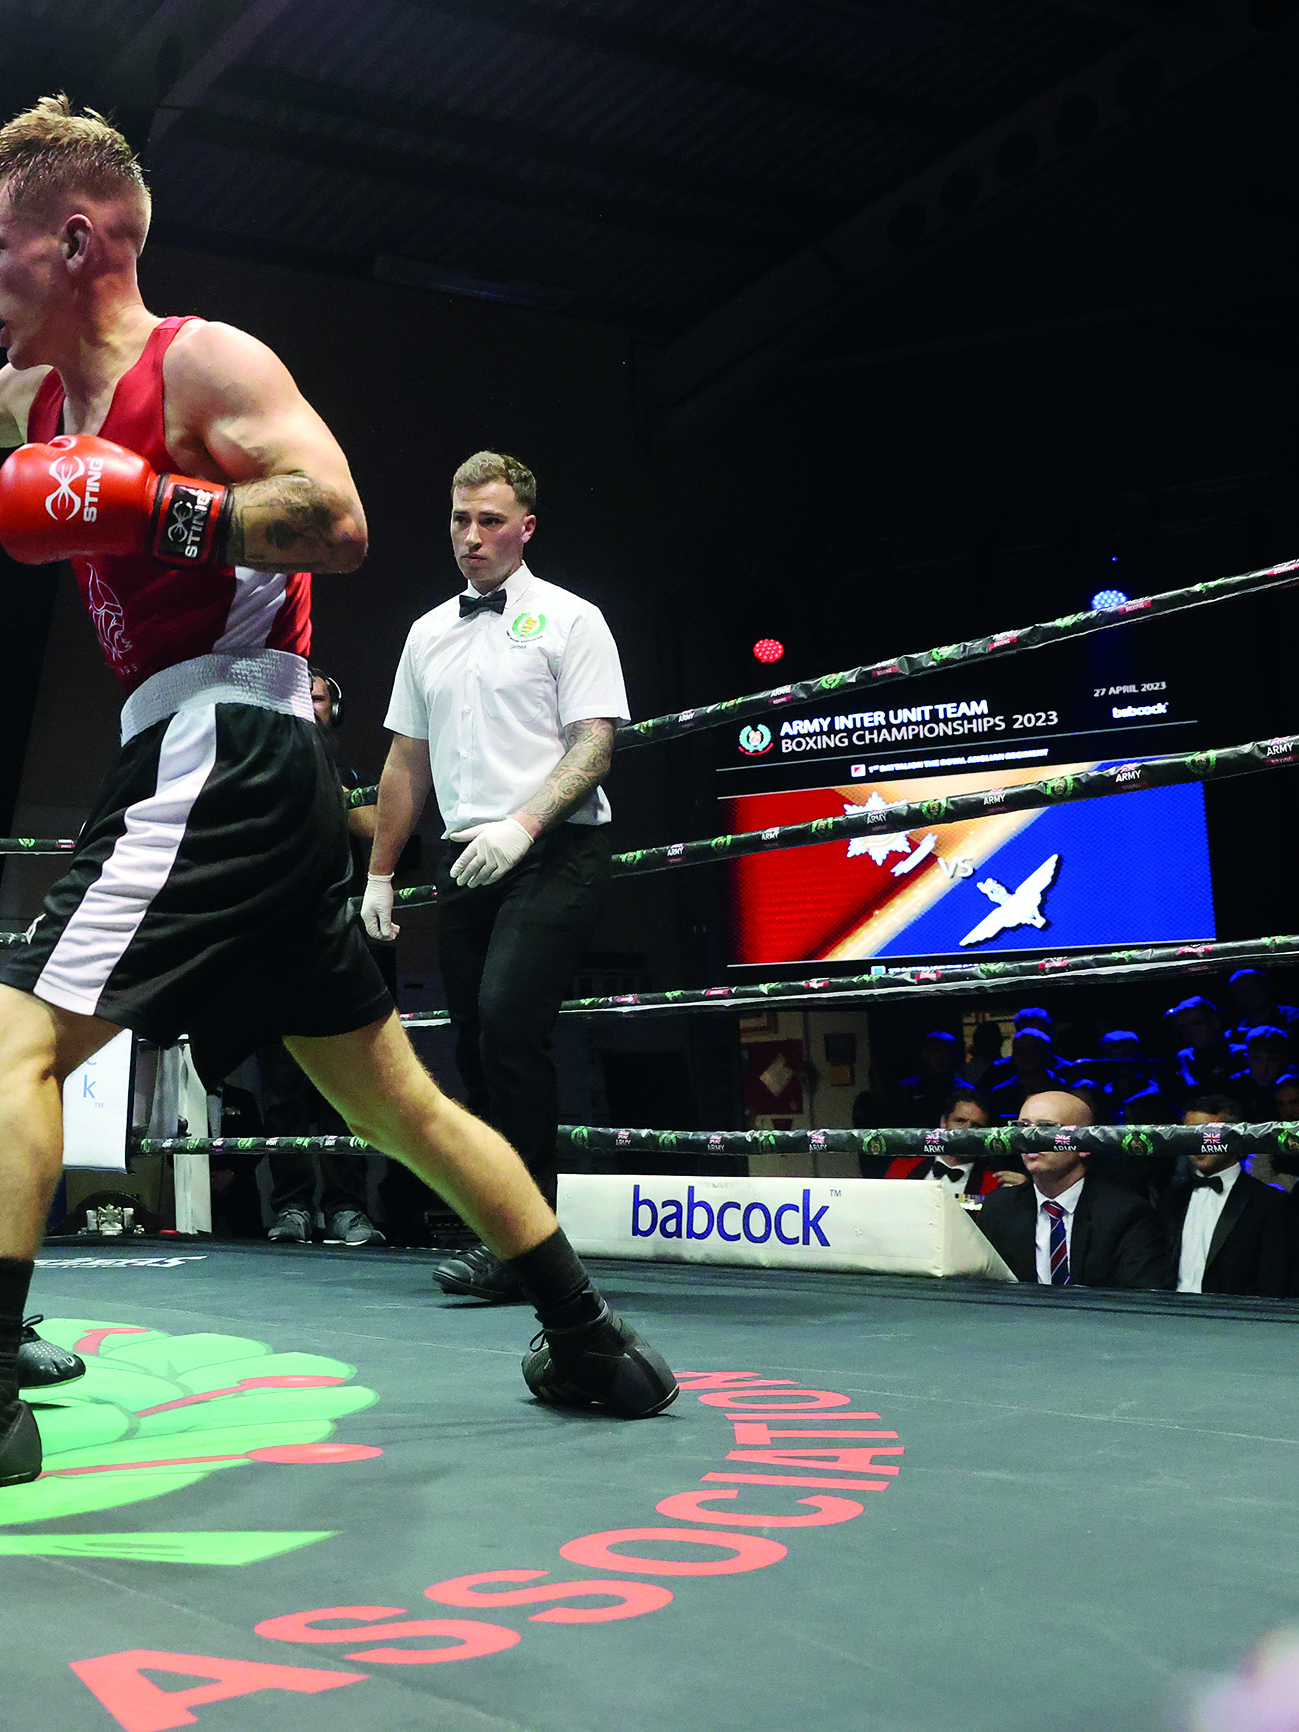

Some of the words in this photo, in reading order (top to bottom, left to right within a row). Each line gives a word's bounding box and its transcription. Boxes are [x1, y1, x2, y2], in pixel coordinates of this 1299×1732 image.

[83, 456, 103, 522] STING
[184, 489, 213, 558] STING
[1093, 688, 1107, 697] 27
[1108, 684, 1139, 696] APRIL
[1140, 681, 1168, 692] 2023
[678, 711, 696, 723] ARMY
[780, 717, 832, 736] ARMY
[834, 711, 887, 730] INTER
[889, 705, 934, 725] UNIT
[933, 699, 989, 719] TEAM
[1111, 703, 1168, 719] babcock
[781, 733, 848, 753] BOXING
[852, 716, 1006, 745] CHAMPIONSHIPS
[1012, 711, 1059, 729] 2023
[1267, 742, 1293, 756] ARMY
[1116, 770, 1141, 783] ARMY
[983, 794, 1006, 805] ARMY
[866, 812, 887, 824] ARMY
[761, 831, 779, 841] ARMY
[667, 847, 684, 857] ARMY
[937, 856, 974, 879] VS
[923, 1144, 945, 1153] ARMY
[1201, 1143, 1228, 1154] ARMY
[632, 1184, 831, 1247] babcock
[68, 1371, 905, 1732] ASSOCIATION
